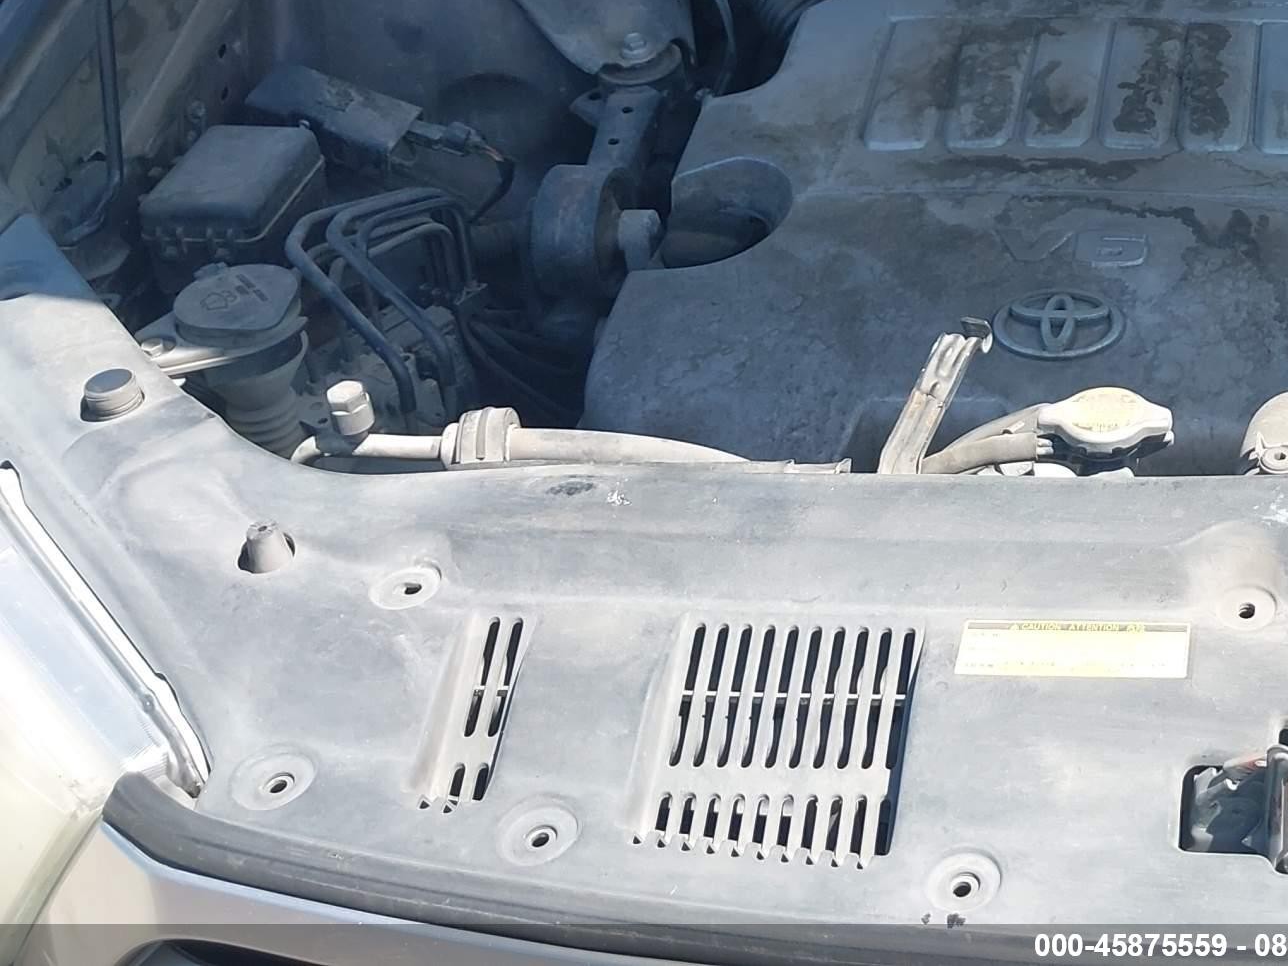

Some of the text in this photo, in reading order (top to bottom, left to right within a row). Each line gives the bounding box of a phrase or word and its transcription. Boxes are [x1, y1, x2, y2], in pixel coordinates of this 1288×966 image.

[994, 229, 1149, 267] V6
[1021, 622, 1061, 631] CAUTION
[1068, 623, 1120, 632] ATTENTION
